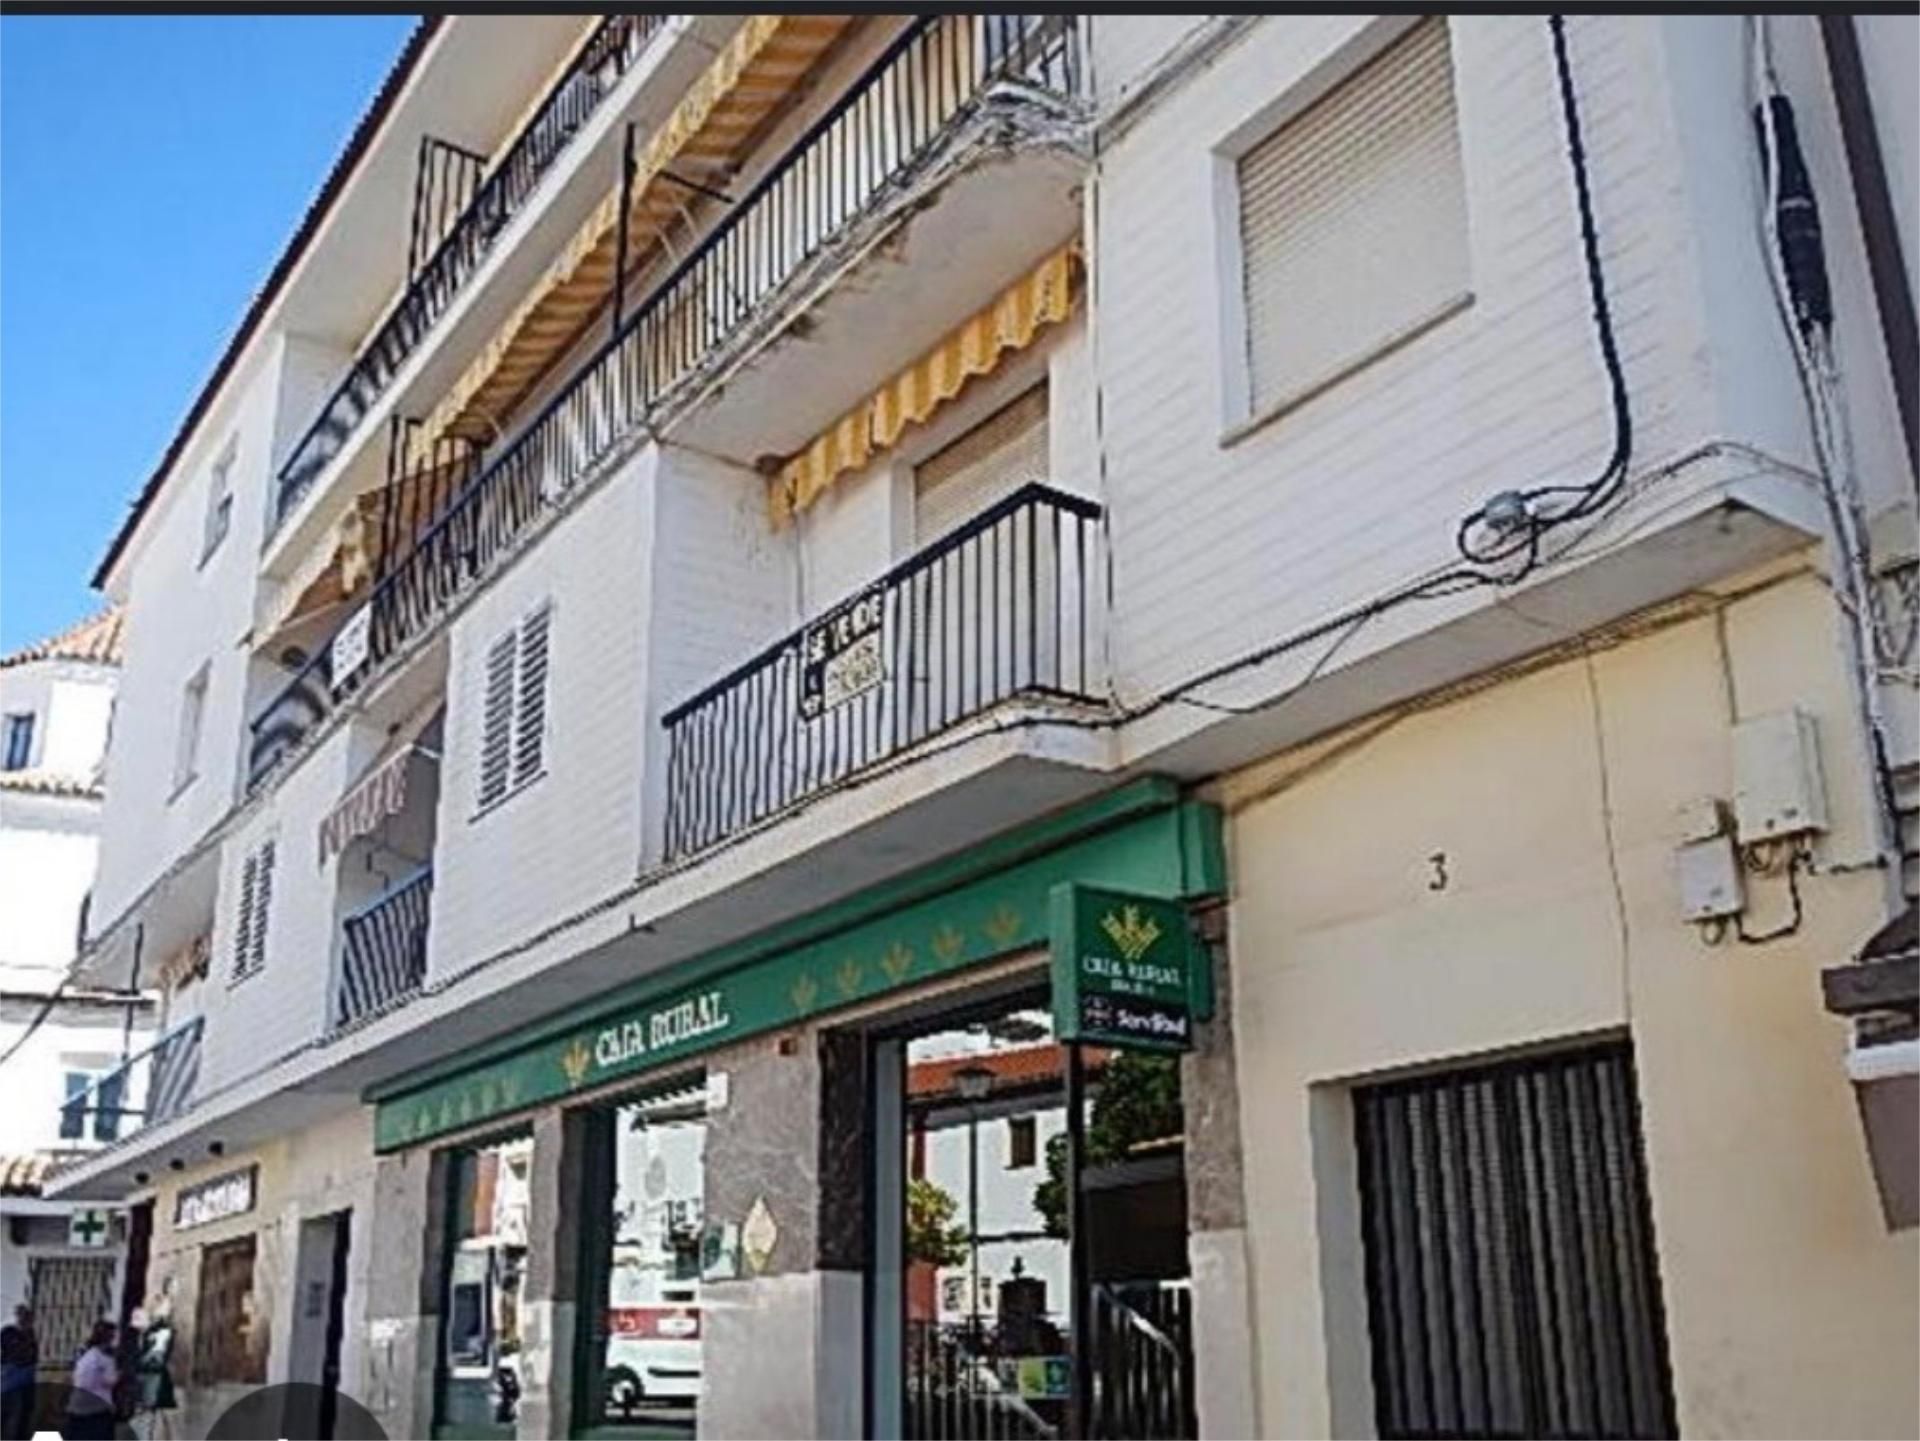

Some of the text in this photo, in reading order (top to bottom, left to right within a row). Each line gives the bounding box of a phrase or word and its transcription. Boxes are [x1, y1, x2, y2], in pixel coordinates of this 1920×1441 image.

[808, 628, 827, 663] SE
[1429, 852, 1448, 891] 3
[596, 991, 729, 1067] CAJA RURAL
